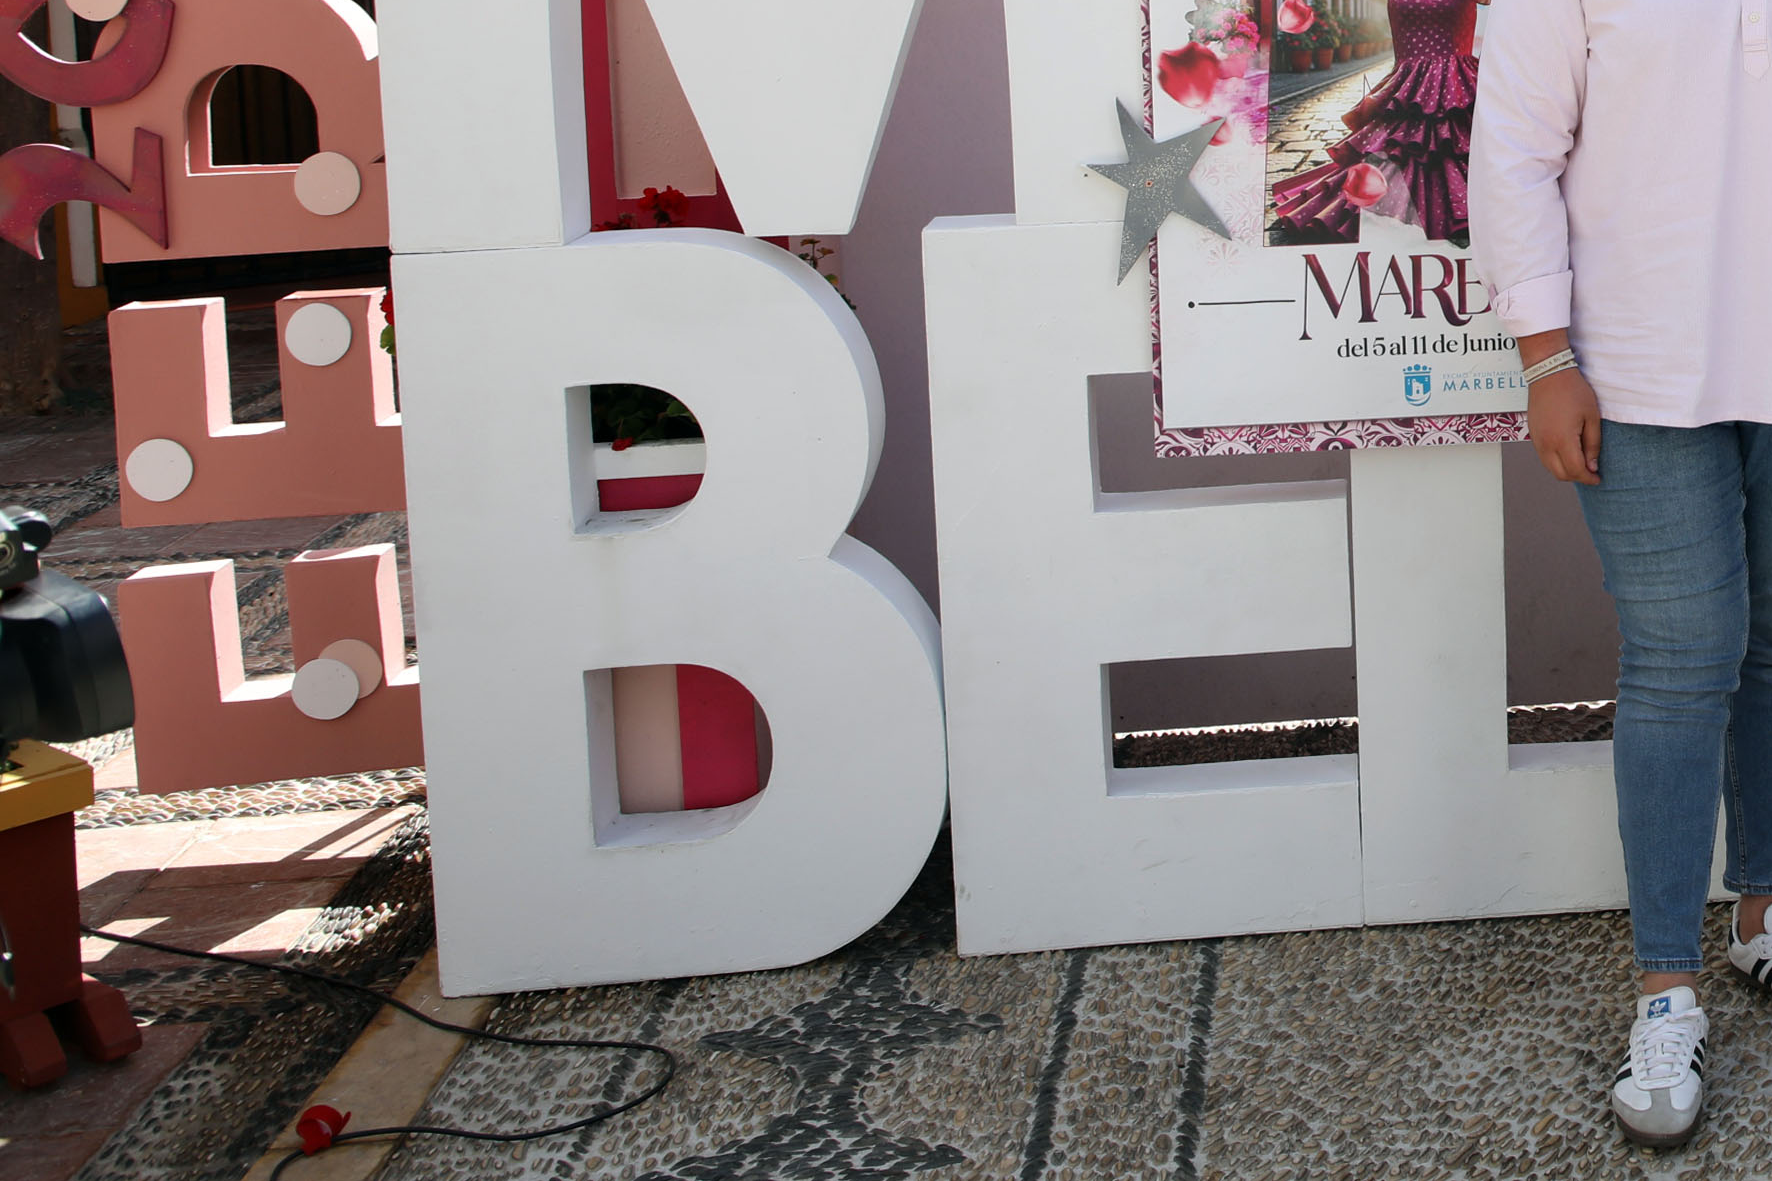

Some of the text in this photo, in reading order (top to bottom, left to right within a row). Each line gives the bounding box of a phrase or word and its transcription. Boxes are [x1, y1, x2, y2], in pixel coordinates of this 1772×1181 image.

[1337, 332, 1516, 358] del 5 al 11 de Junio
[1443, 376, 1527, 392] MARBELL
